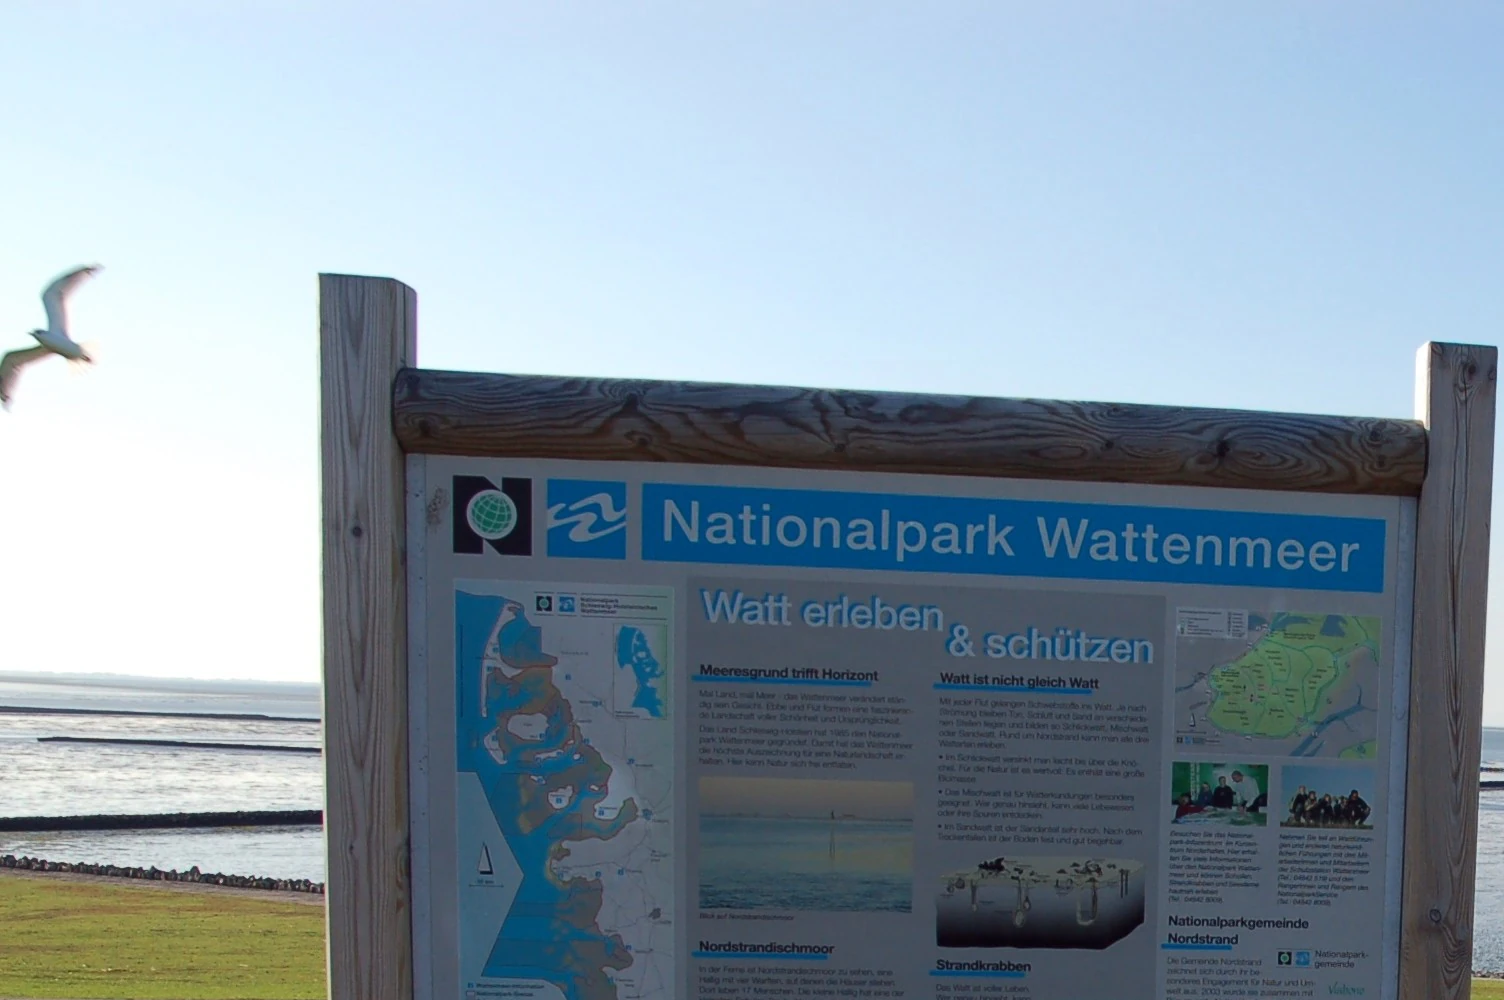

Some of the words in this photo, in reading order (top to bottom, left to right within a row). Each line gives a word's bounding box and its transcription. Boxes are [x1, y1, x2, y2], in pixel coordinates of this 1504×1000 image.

[663, 499, 1015, 562] Nationalpark
[1035, 514, 1362, 573] Wattenmeer
[701, 591, 793, 626] Watt
[803, 597, 945, 633] erleben
[948, 624, 974, 657] &
[986, 626, 1154, 664] schützen
[700, 664, 789, 681] Meeresgrund
[793, 667, 820, 680] trifft
[823, 668, 880, 682] Horizont
[940, 672, 970, 685] Watt
[972, 673, 989, 685] ist
[991, 673, 1024, 687] nicht
[1026, 675, 1066, 691] gleich
[1068, 677, 1099, 689] Watt
[1168, 914, 1310, 931] Nationalparkgemeinde
[699, 940, 835, 954] Nordstrandischmoor
[1168, 932, 1239, 945] Nordstrand
[1315, 950, 1369, 960] Nationalpark-
[936, 958, 1032, 972] Strandkrabben
[1314, 960, 1355, 968] gemeinde
